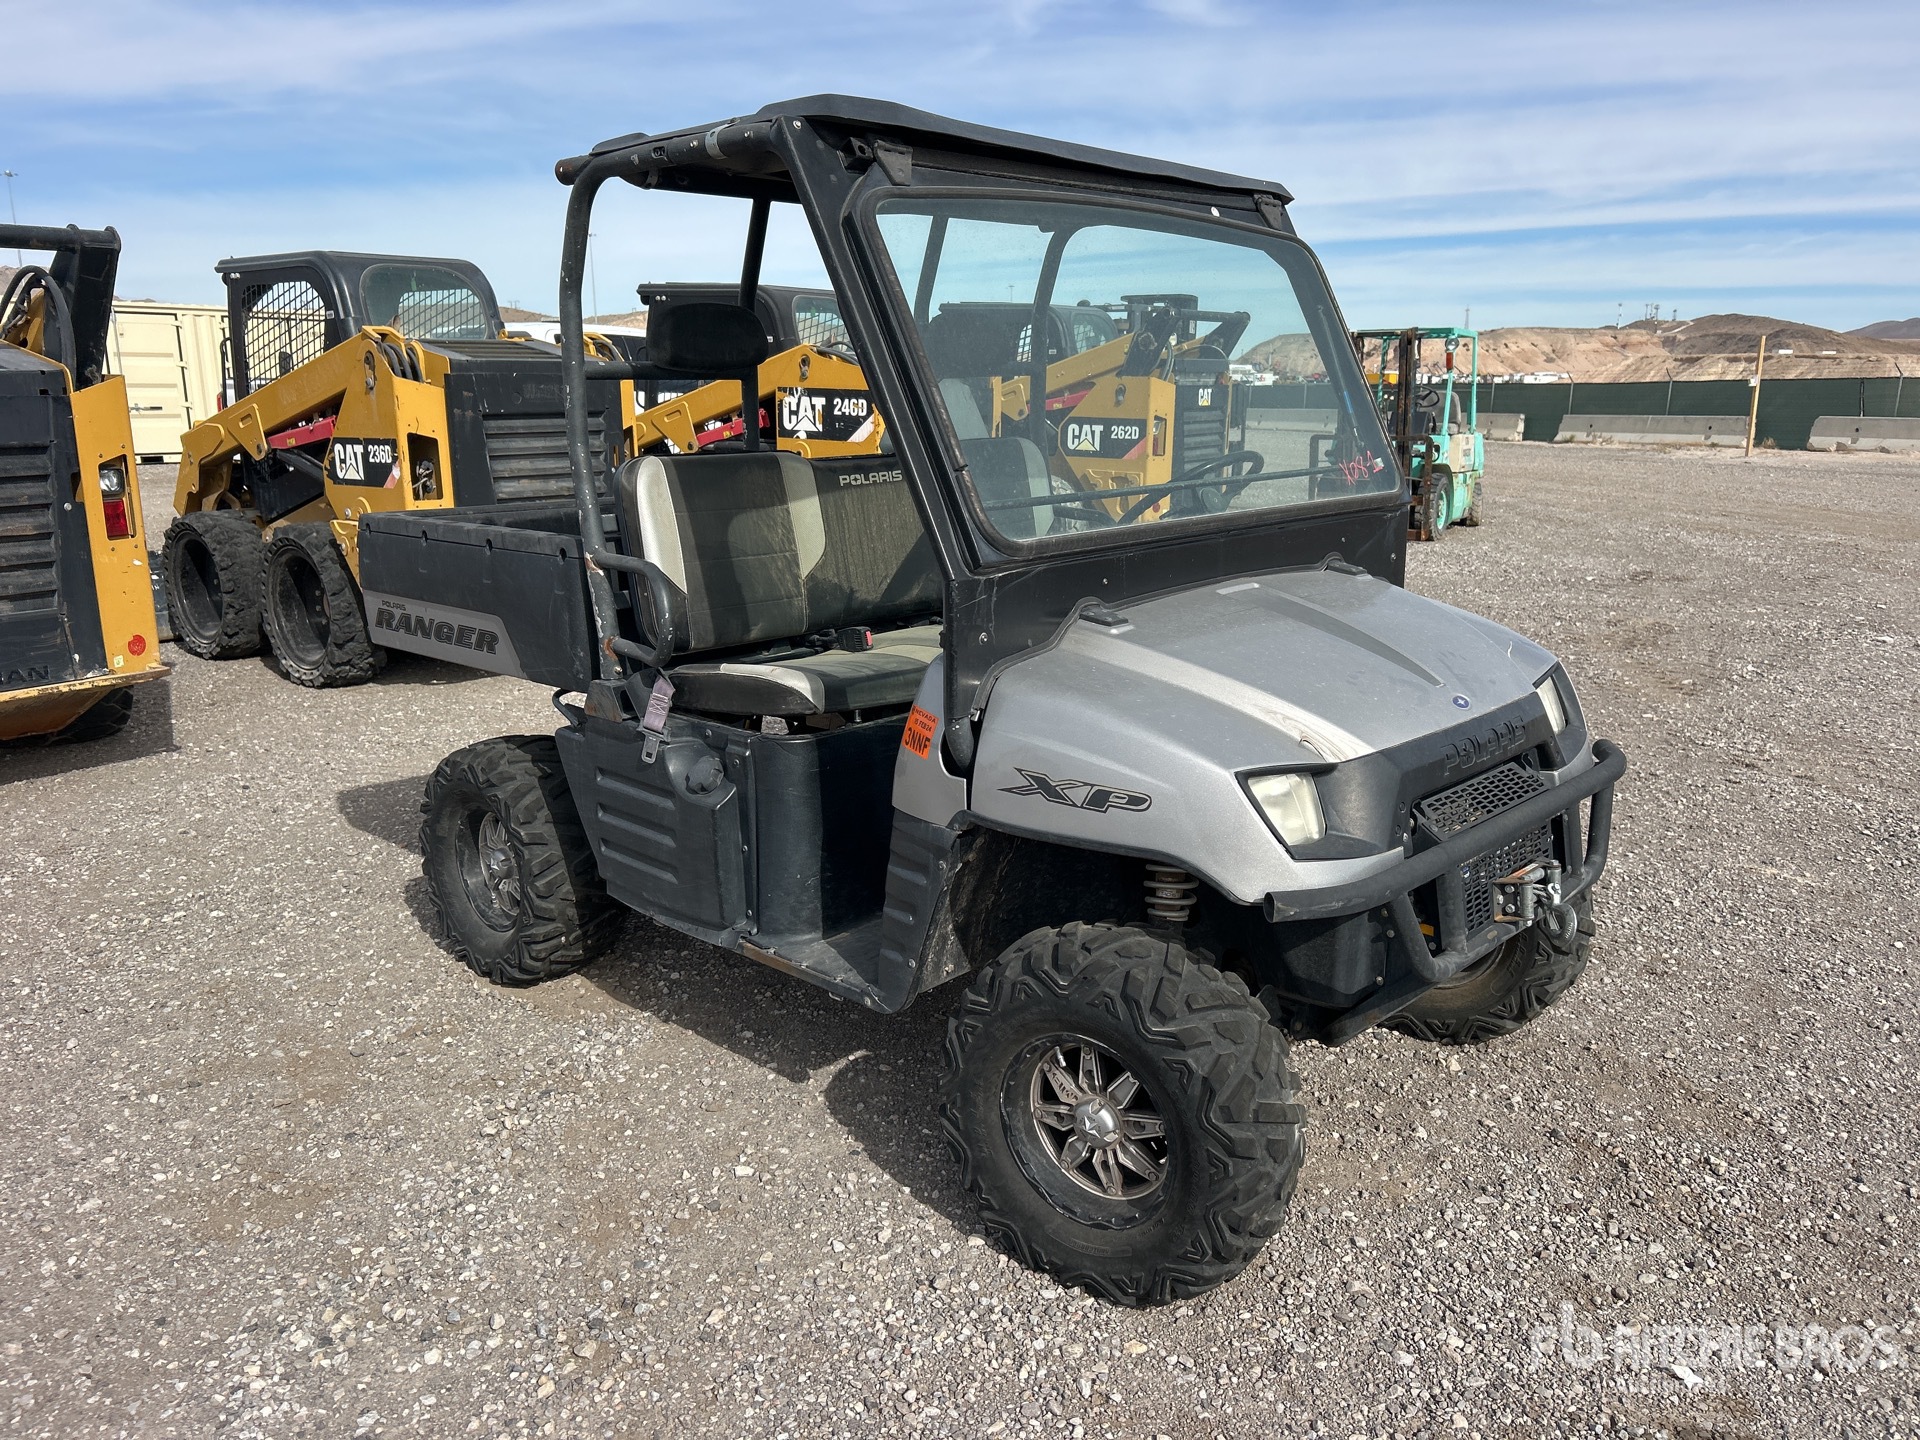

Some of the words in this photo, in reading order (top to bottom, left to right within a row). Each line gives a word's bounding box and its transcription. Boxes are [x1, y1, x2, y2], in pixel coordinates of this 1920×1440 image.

[1198, 388, 1212, 406] CAT
[782, 396, 825, 432] CAT
[833, 398, 867, 416] 246D
[1067, 423, 1103, 451] CAT
[1111, 425, 1139, 440] 262D
[334, 443, 364, 480] CAT
[368, 444, 392, 463] 236D
[839, 470, 903, 487] POLARIS
[382, 600, 406, 611] POLARIS
[375, 608, 499, 655] RANGER
[0, 664, 49, 686] AN
[914, 708, 936, 724] NEVADA
[905, 727, 931, 756] 3NNF
[1440, 715, 1526, 776] POLARIS
[996, 767, 1152, 814] XP
